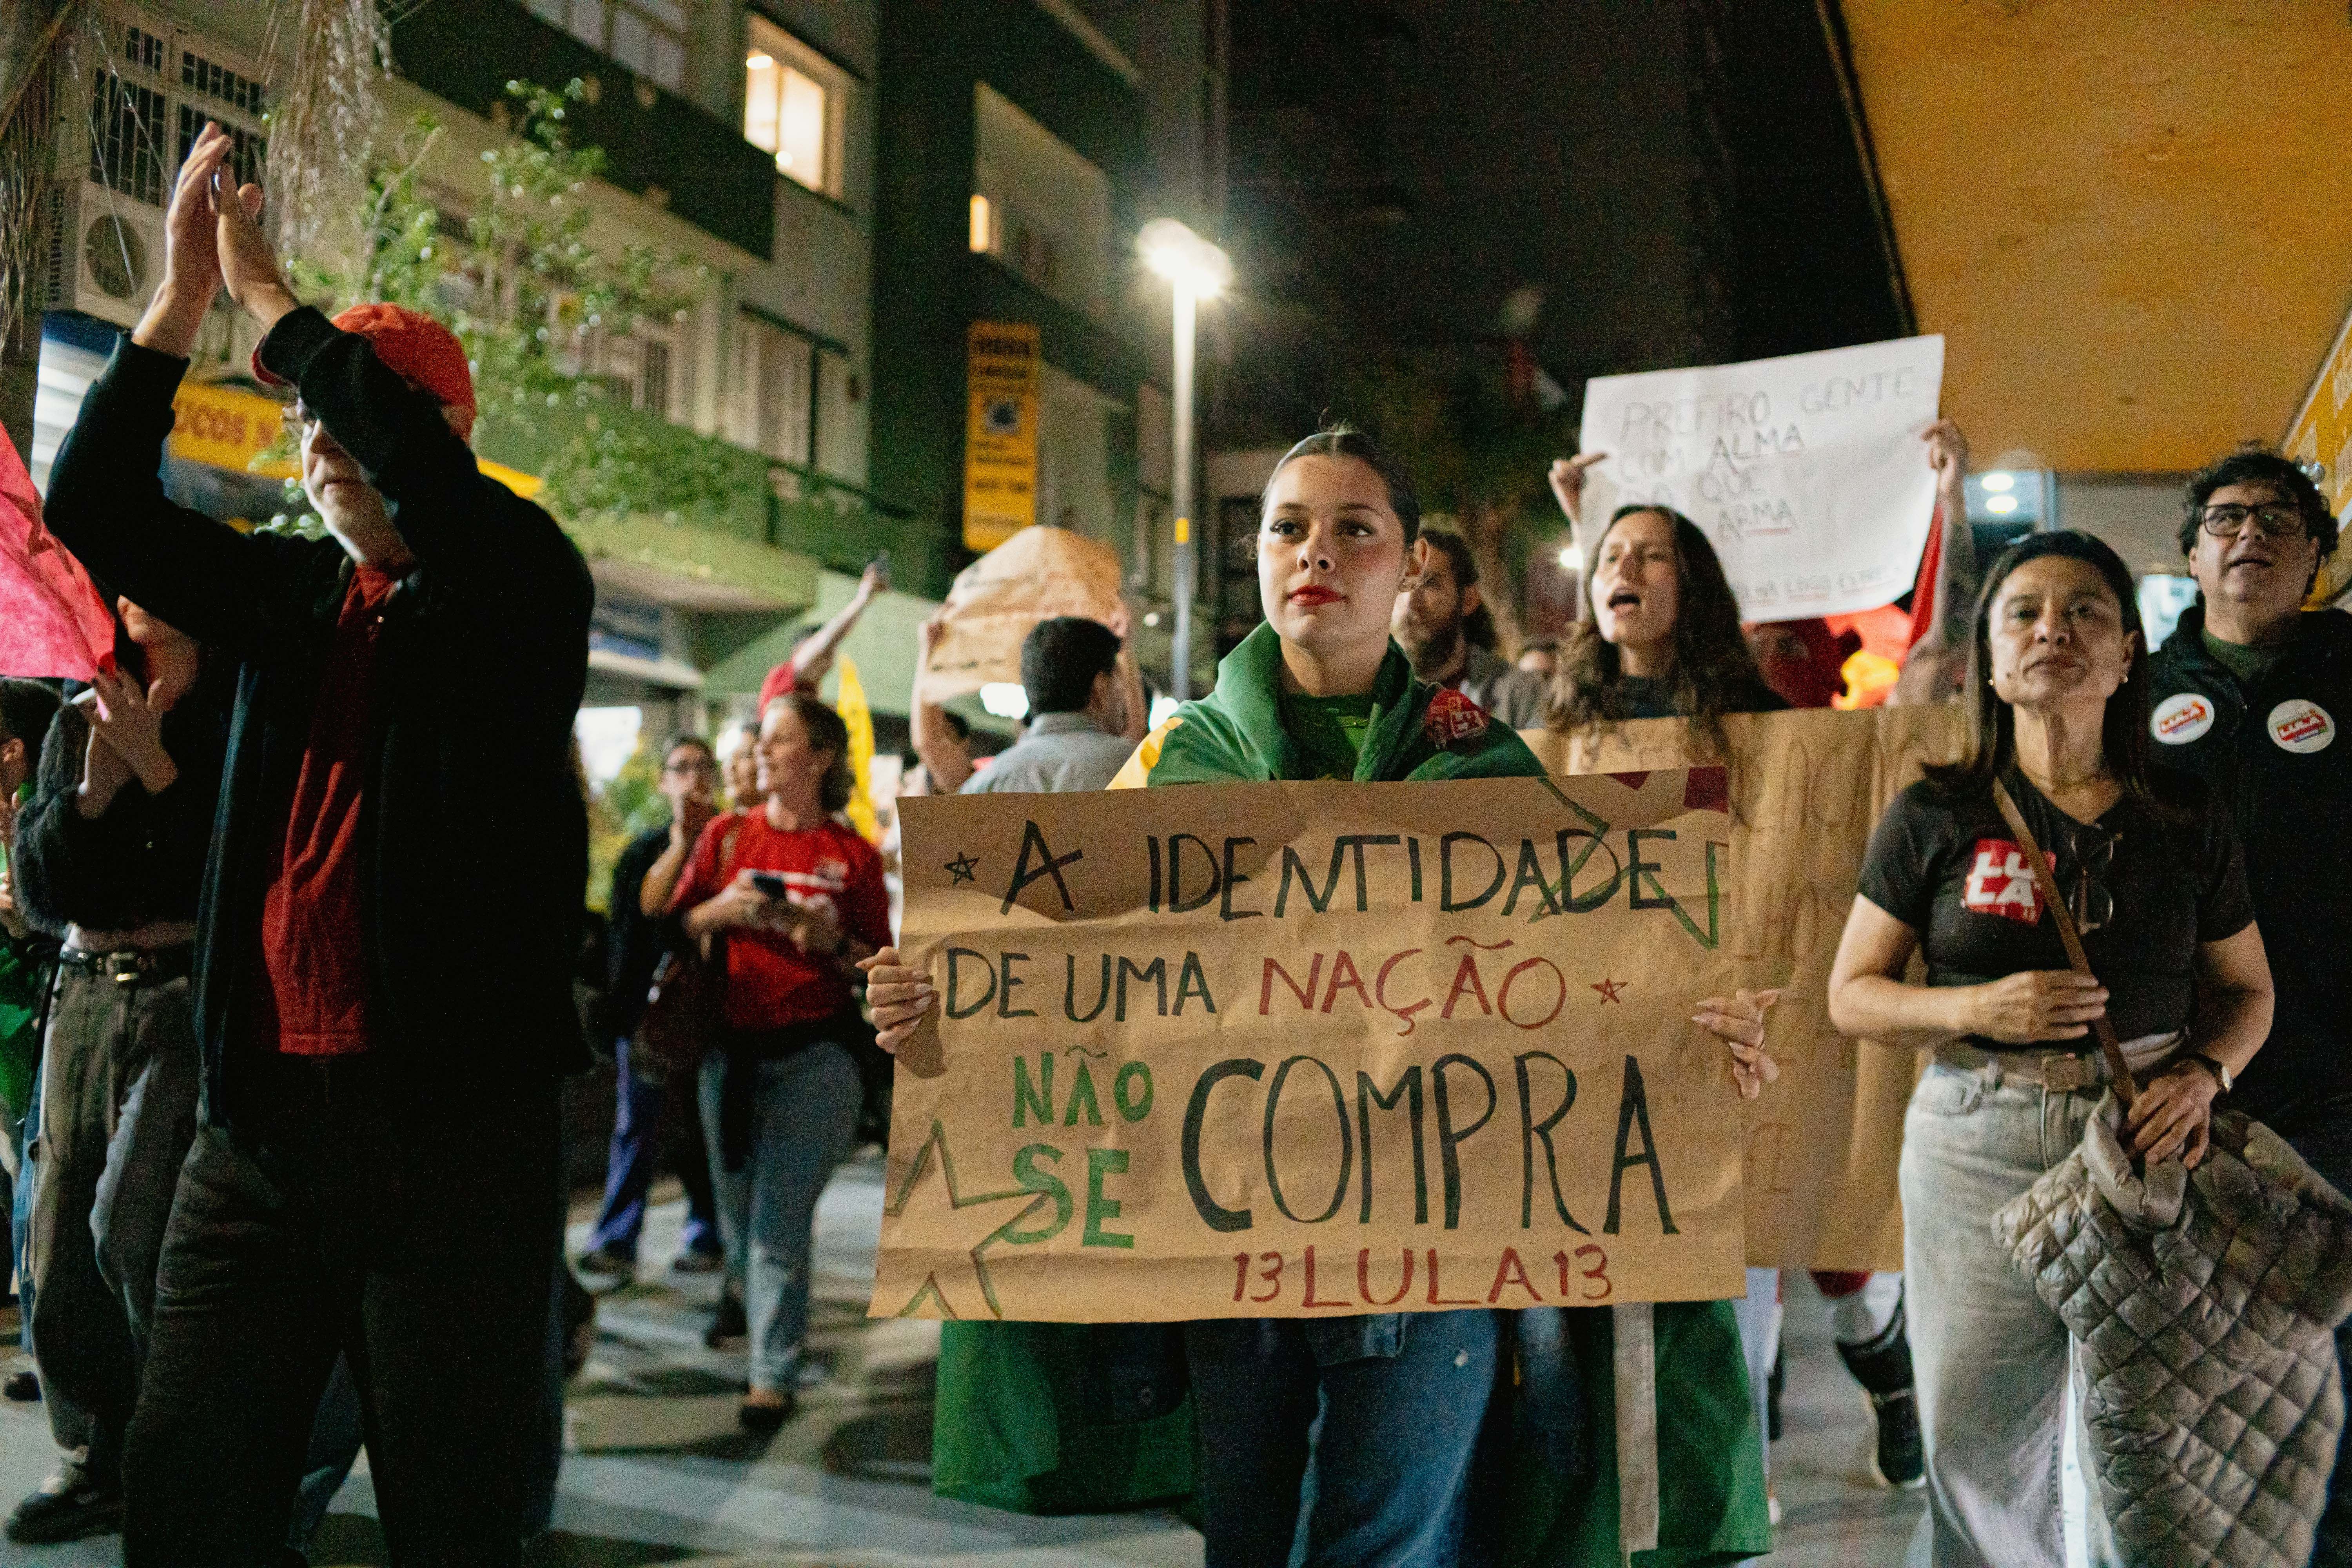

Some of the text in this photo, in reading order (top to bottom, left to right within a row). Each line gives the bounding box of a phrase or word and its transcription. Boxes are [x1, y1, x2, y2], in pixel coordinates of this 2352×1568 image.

[1801, 366, 1915, 416] GENTE
[1694, 465, 1766, 503] QUE
[1705, 423, 1805, 476] ALMA
[1719, 497, 1799, 544] ARMA
[1000, 820, 1677, 922] A IDENTIDADE
[945, 935, 1567, 1037] DE UMA NAÇÃO
[1012, 1045, 1154, 1129] NÃO
[1181, 1051, 1681, 1236] COMPRA
[1000, 1143, 1135, 1249] SE
